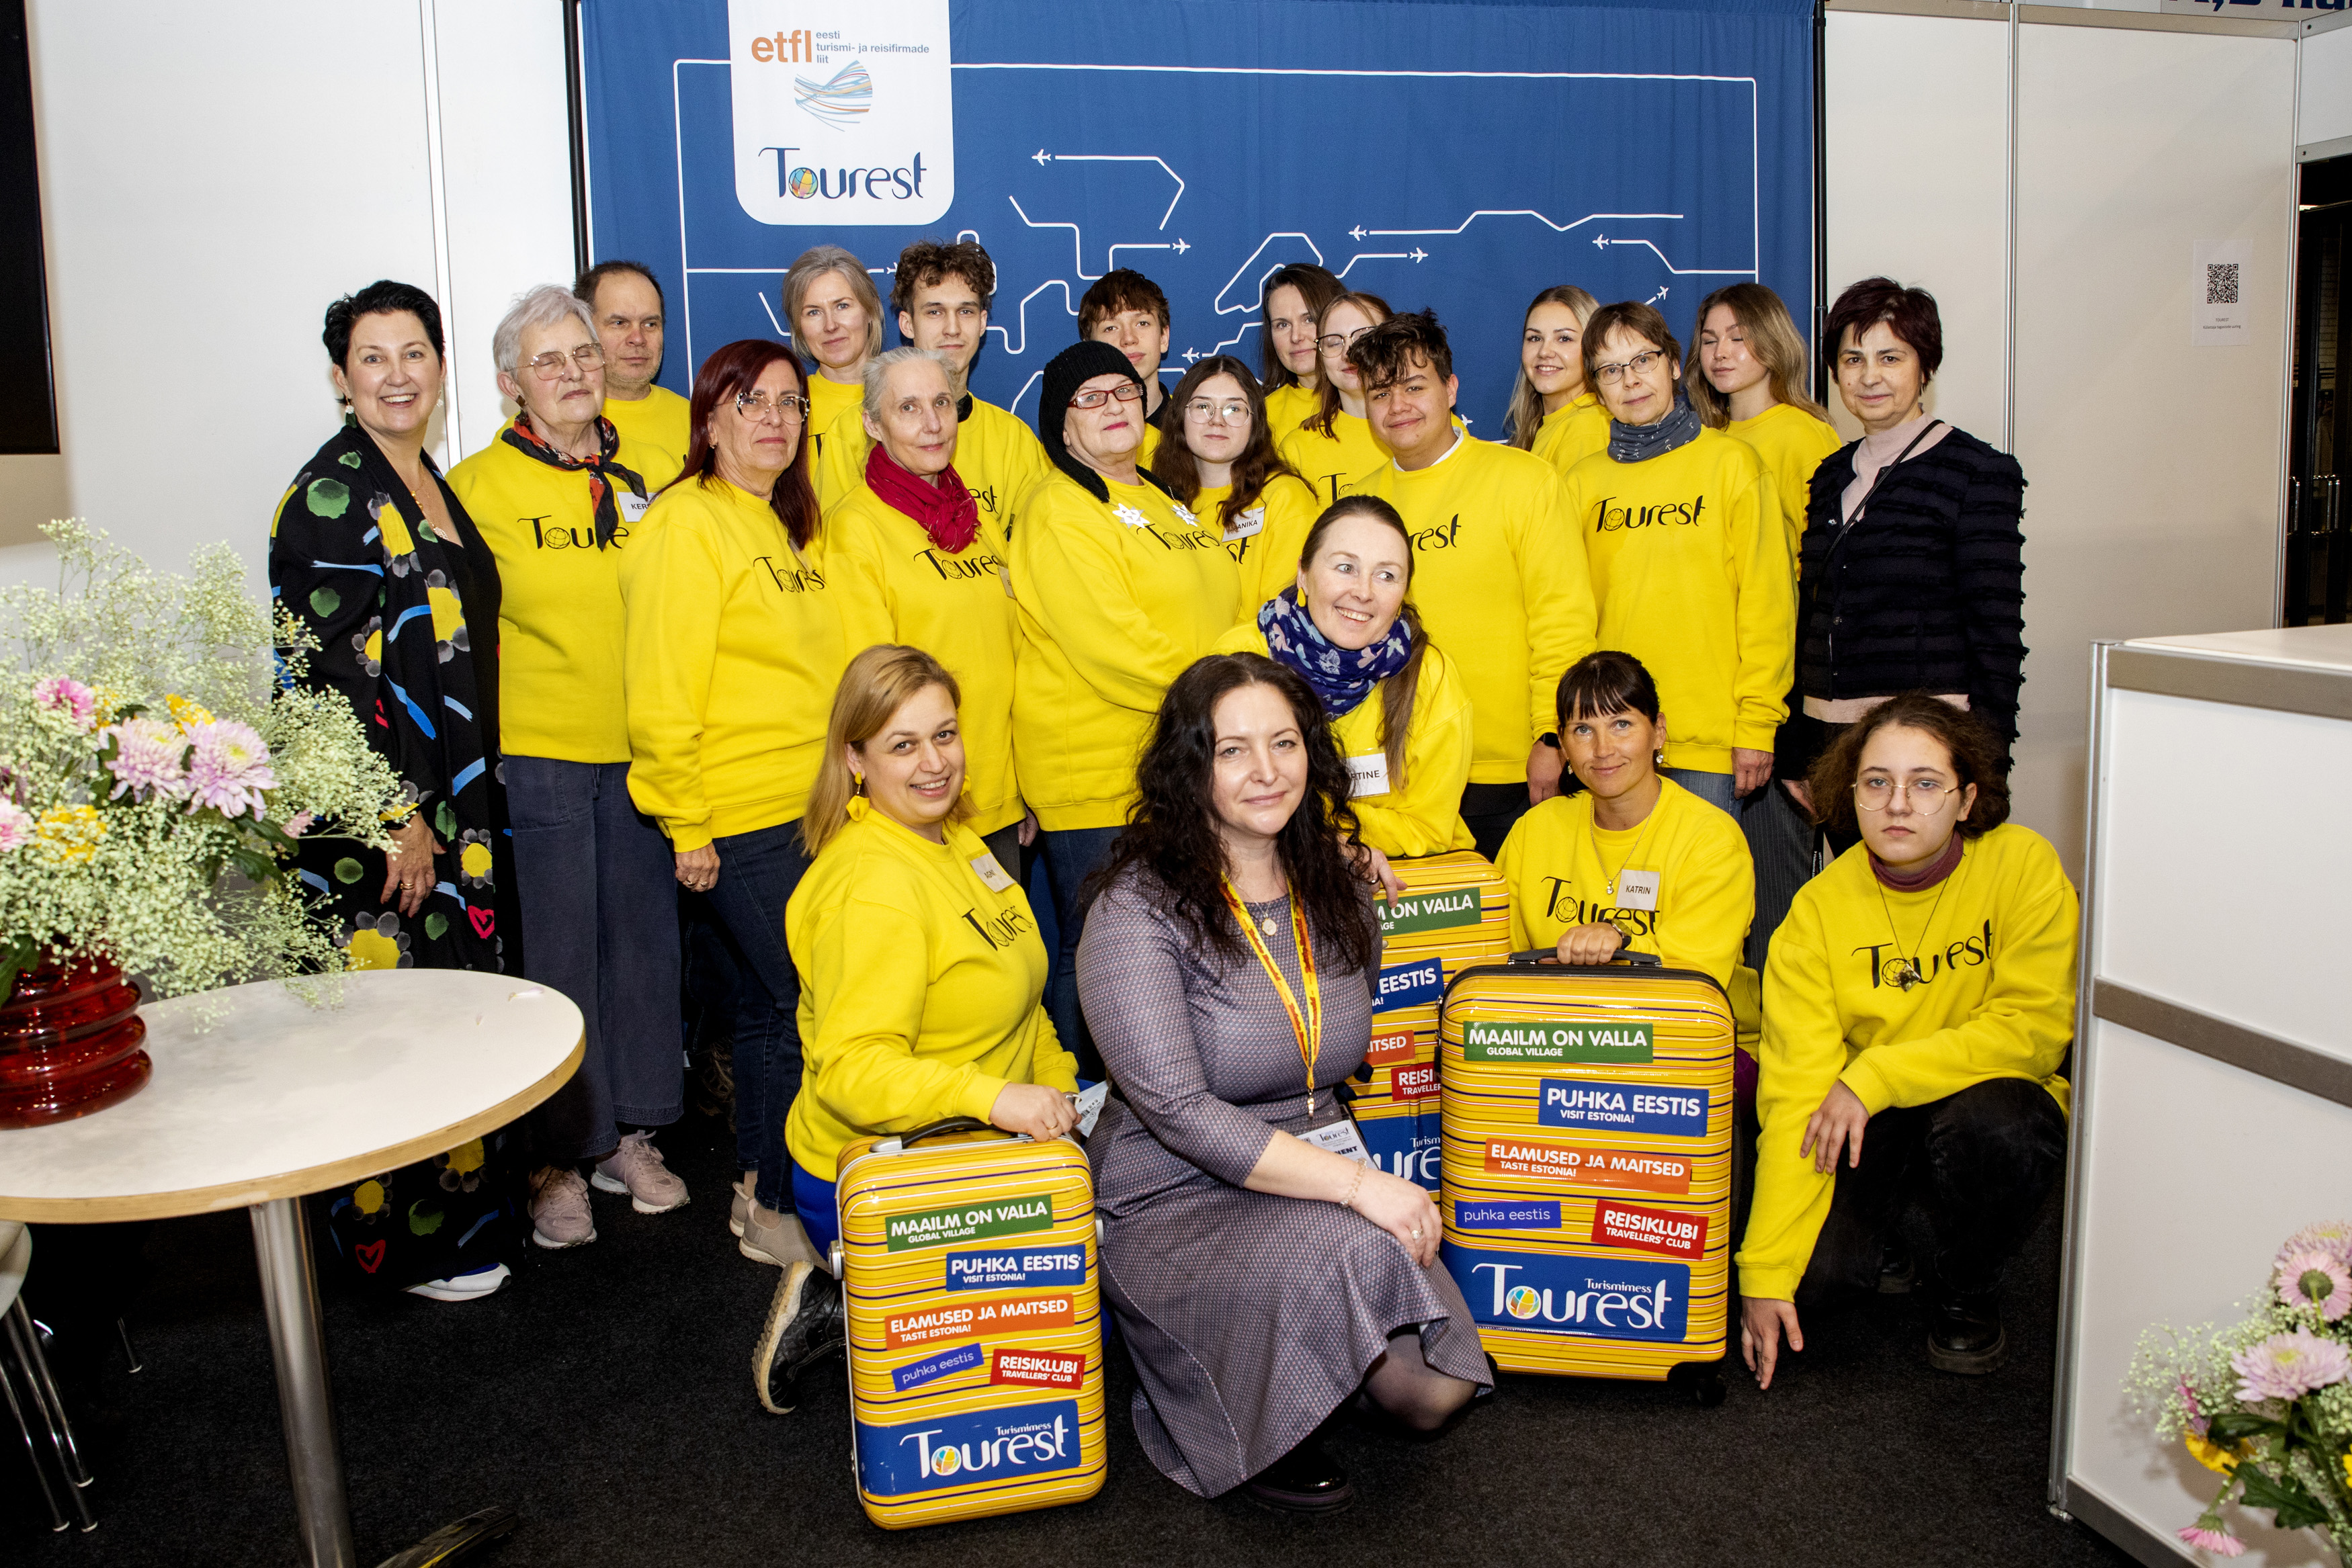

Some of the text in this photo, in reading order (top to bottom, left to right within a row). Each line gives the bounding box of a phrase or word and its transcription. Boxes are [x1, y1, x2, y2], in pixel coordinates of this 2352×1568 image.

[816, 31, 840, 40] eesti
[751, 30, 812, 62] etfl
[816, 42, 929, 53] turismi- ja reisifirmade
[816, 54, 829, 64] liit
[758, 147, 927, 200] Tourest
[1592, 495, 1706, 533] Tourest
[517, 515, 629, 550] Toue
[1626, 885, 1651, 895] KATRIN
[1391, 901, 1418, 919] ON
[1422, 894, 1474, 915] VALLA
[1379, 967, 1436, 994] EESTIS
[1367, 1036, 1406, 1053] ITSED
[1469, 1029, 1647, 1046] MAAILM ON VALLA
[1486, 1047, 1563, 1057] GLOBAL VILLAGE
[1547, 1088, 1701, 1117] PUHKA EESTIS
[1560, 1109, 1635, 1123] VISIT ESTONIA!
[1316, 1127, 1349, 1141] Tourest
[1491, 1144, 1684, 1177] ELAMUSED JA MAITSED
[1501, 1160, 1577, 1177] TASTE ESTONIA!
[891, 1201, 1048, 1237] MAAILM ON VALLA
[1464, 1208, 1550, 1223] puhka eestis
[1603, 1209, 1698, 1240] REISIKLUBI
[908, 1226, 976, 1244] GLOBAL VILLAGE
[1666, 1236, 1691, 1250] CLUB
[951, 1256, 1018, 1275] PUHKA
[963, 1273, 1025, 1283] VISIT ESTONIA!
[1585, 1278, 1652, 1293] Turismimess
[1472, 1262, 1672, 1330] Tourest
[890, 1299, 1068, 1334] ELAMUSED JA MAITSED
[900, 1324, 972, 1342] TASTE ESTONIA!
[902, 1352, 974, 1385] puhka eestis
[999, 1356, 1078, 1374] REISIKLUBI
[1051, 1373, 1073, 1382] CLUB
[995, 1422, 1052, 1436] Turismimess
[899, 1414, 1069, 1479] Tourest
